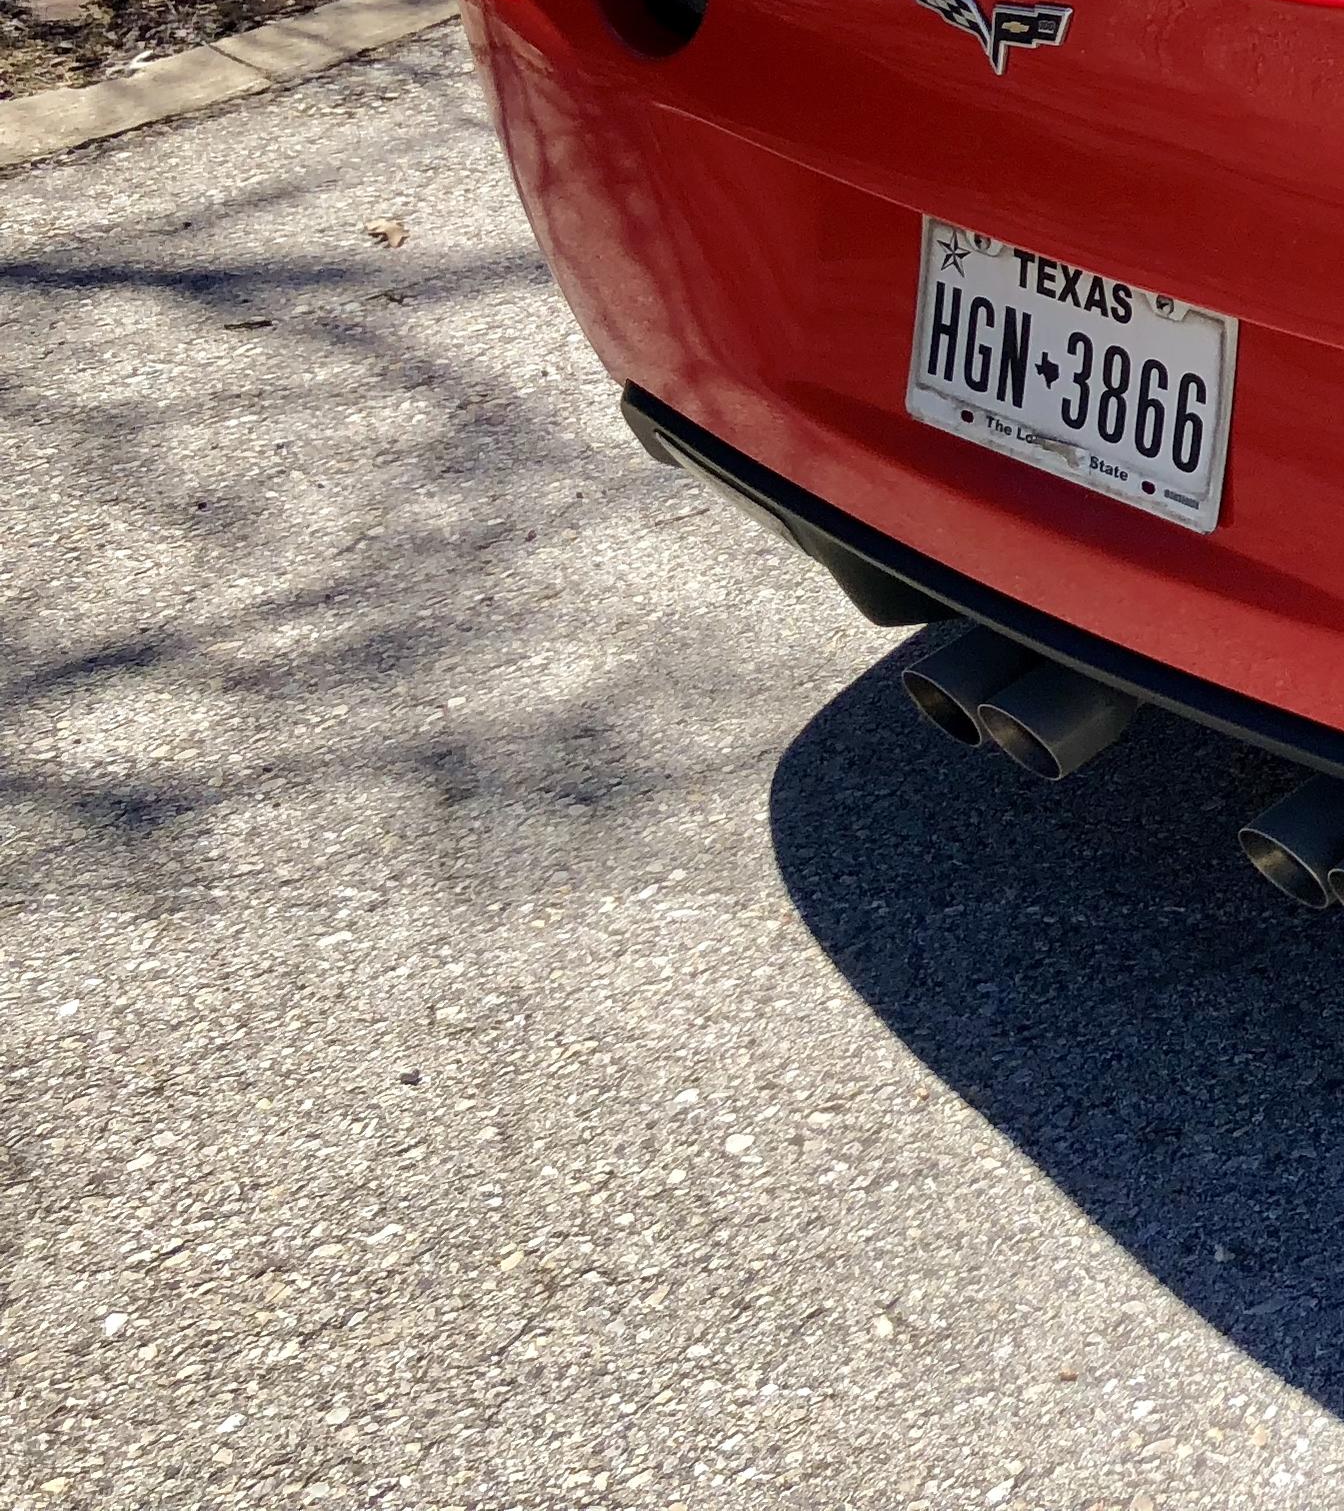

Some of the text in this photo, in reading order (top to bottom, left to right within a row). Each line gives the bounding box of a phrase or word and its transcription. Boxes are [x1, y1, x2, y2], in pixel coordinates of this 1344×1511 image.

[1014, 249, 1133, 324] TEXAS
[985, 416, 1012, 436] The
[1089, 455, 1129, 482] State
